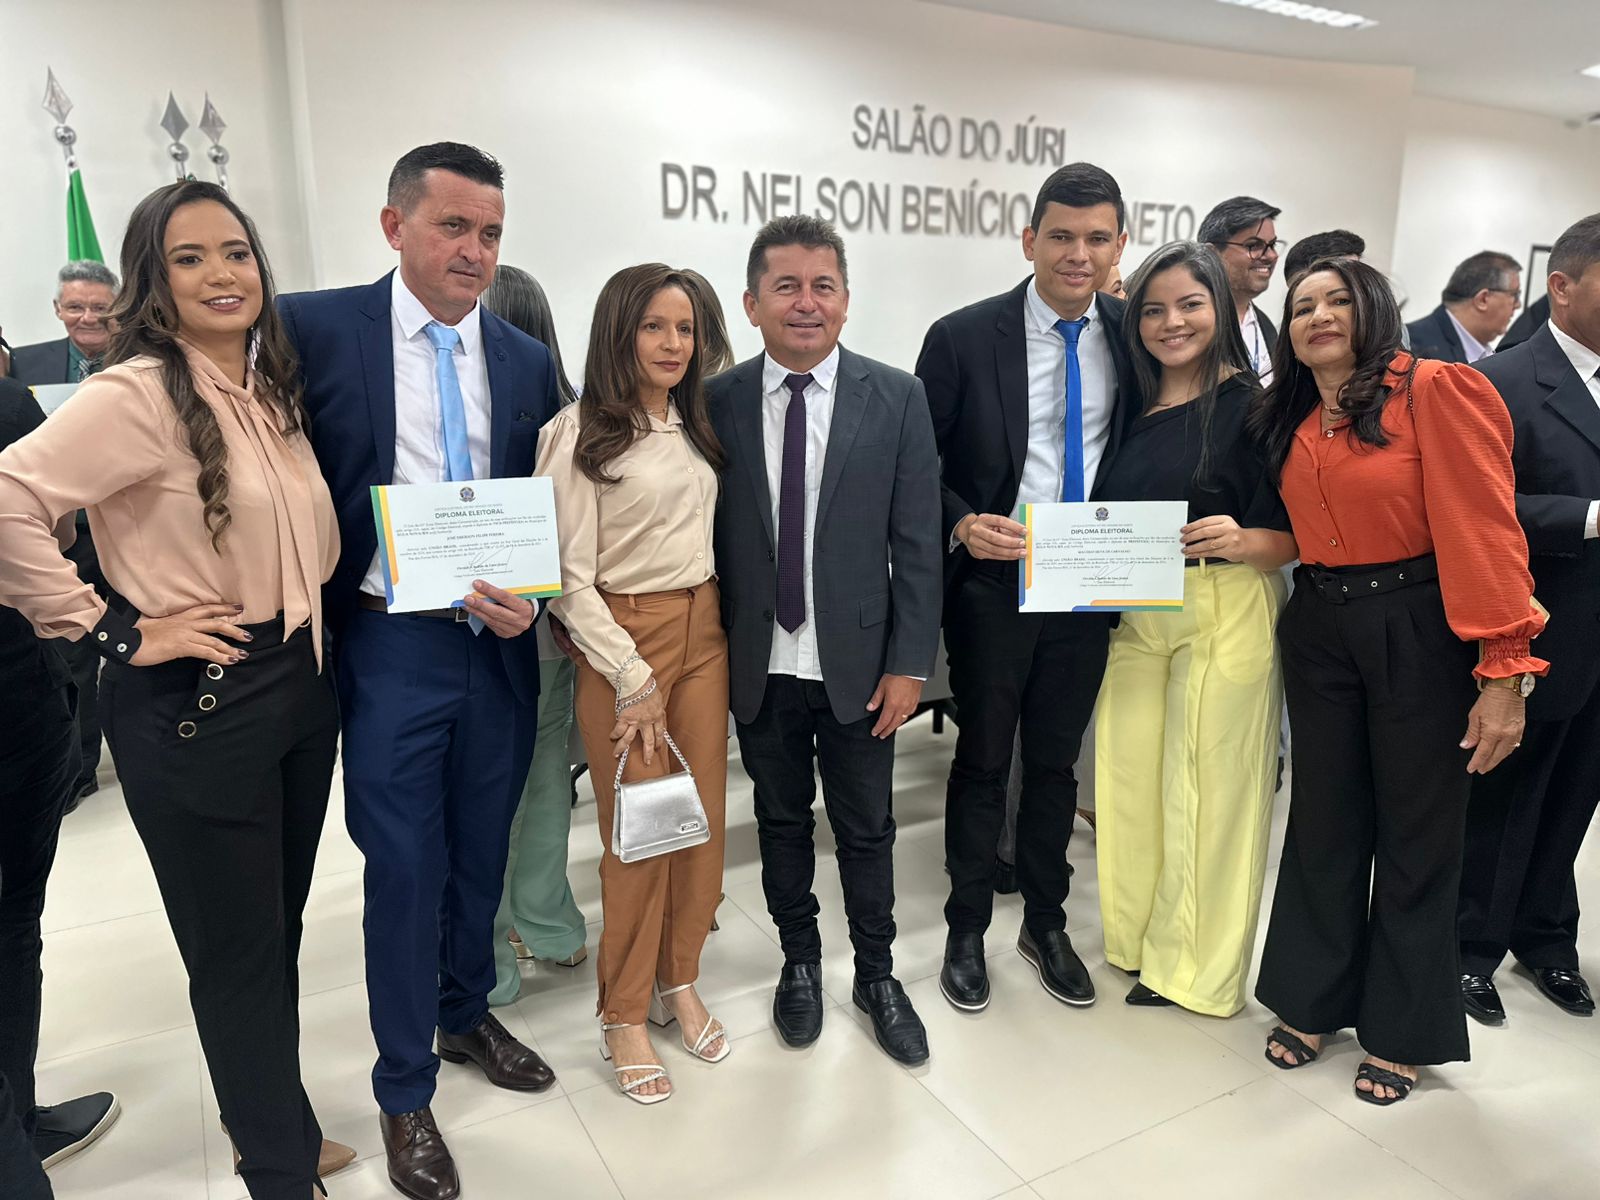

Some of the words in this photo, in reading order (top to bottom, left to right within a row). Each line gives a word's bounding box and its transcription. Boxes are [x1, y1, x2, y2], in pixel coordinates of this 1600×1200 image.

[852, 103, 952, 156] SALÃO
[959, 117, 1001, 161] DO
[1006, 114, 1067, 167] JÚRI
[660, 162, 728, 223] DR.
[901, 178, 1033, 240] BENÍCIO
[1123, 201, 1196, 246] NETO
[434, 511, 467, 519] DIPLOMA
[468, 508, 505, 517] ELEITORAL
